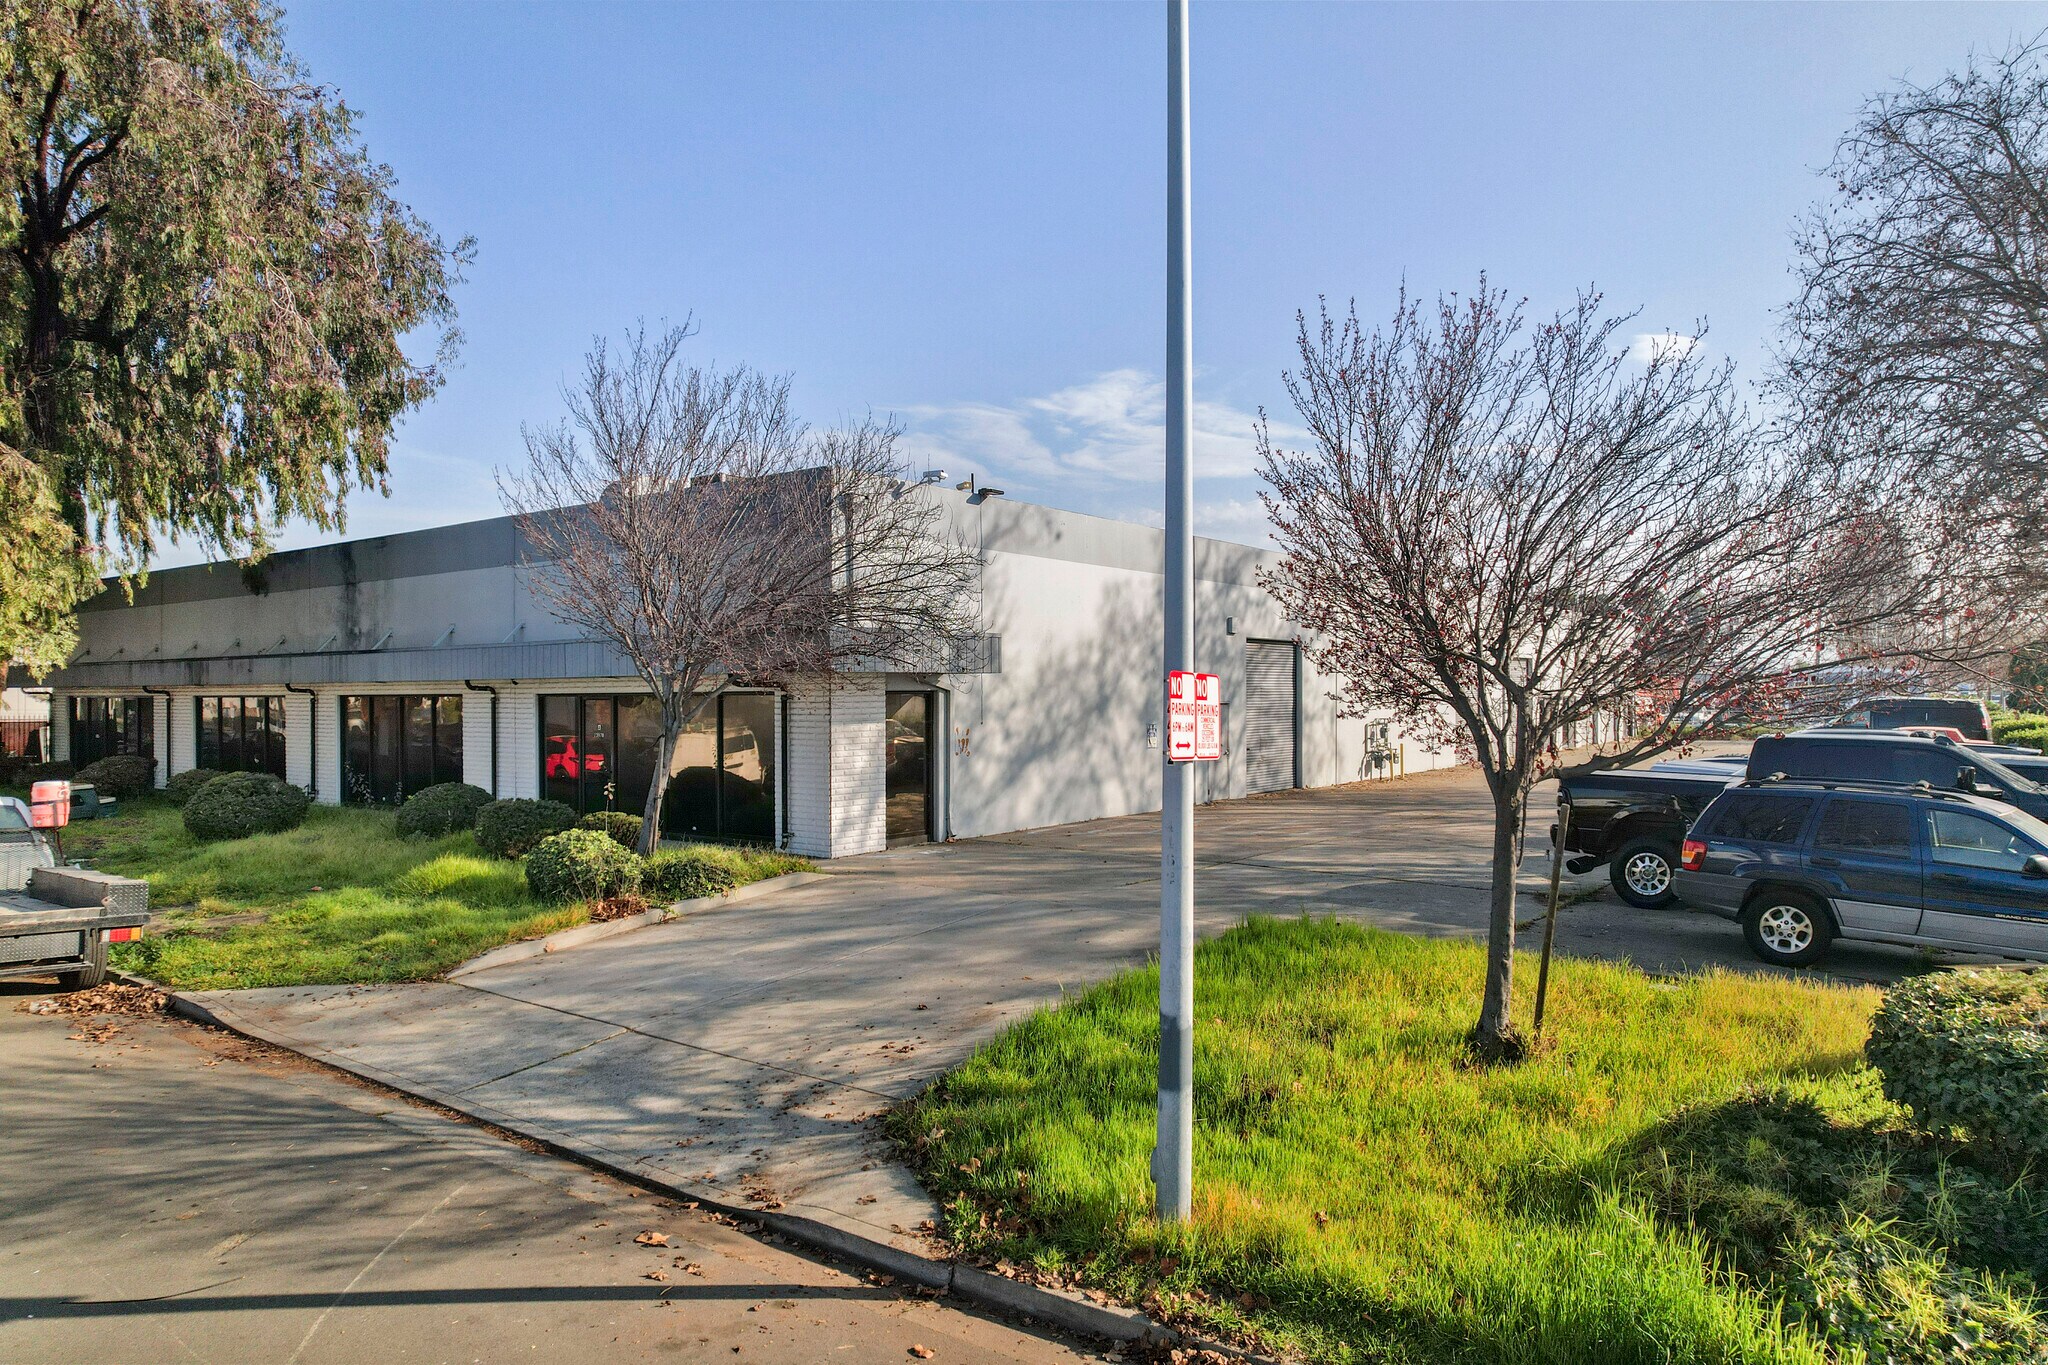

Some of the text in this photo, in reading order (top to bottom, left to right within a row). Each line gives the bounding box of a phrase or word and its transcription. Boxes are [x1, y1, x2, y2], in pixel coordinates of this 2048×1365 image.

[1171, 677, 1182, 695] NO
[1197, 679, 1207, 697] NO
[1172, 702, 1194, 715] PARKING
[1198, 704, 1218, 717] PARKING
